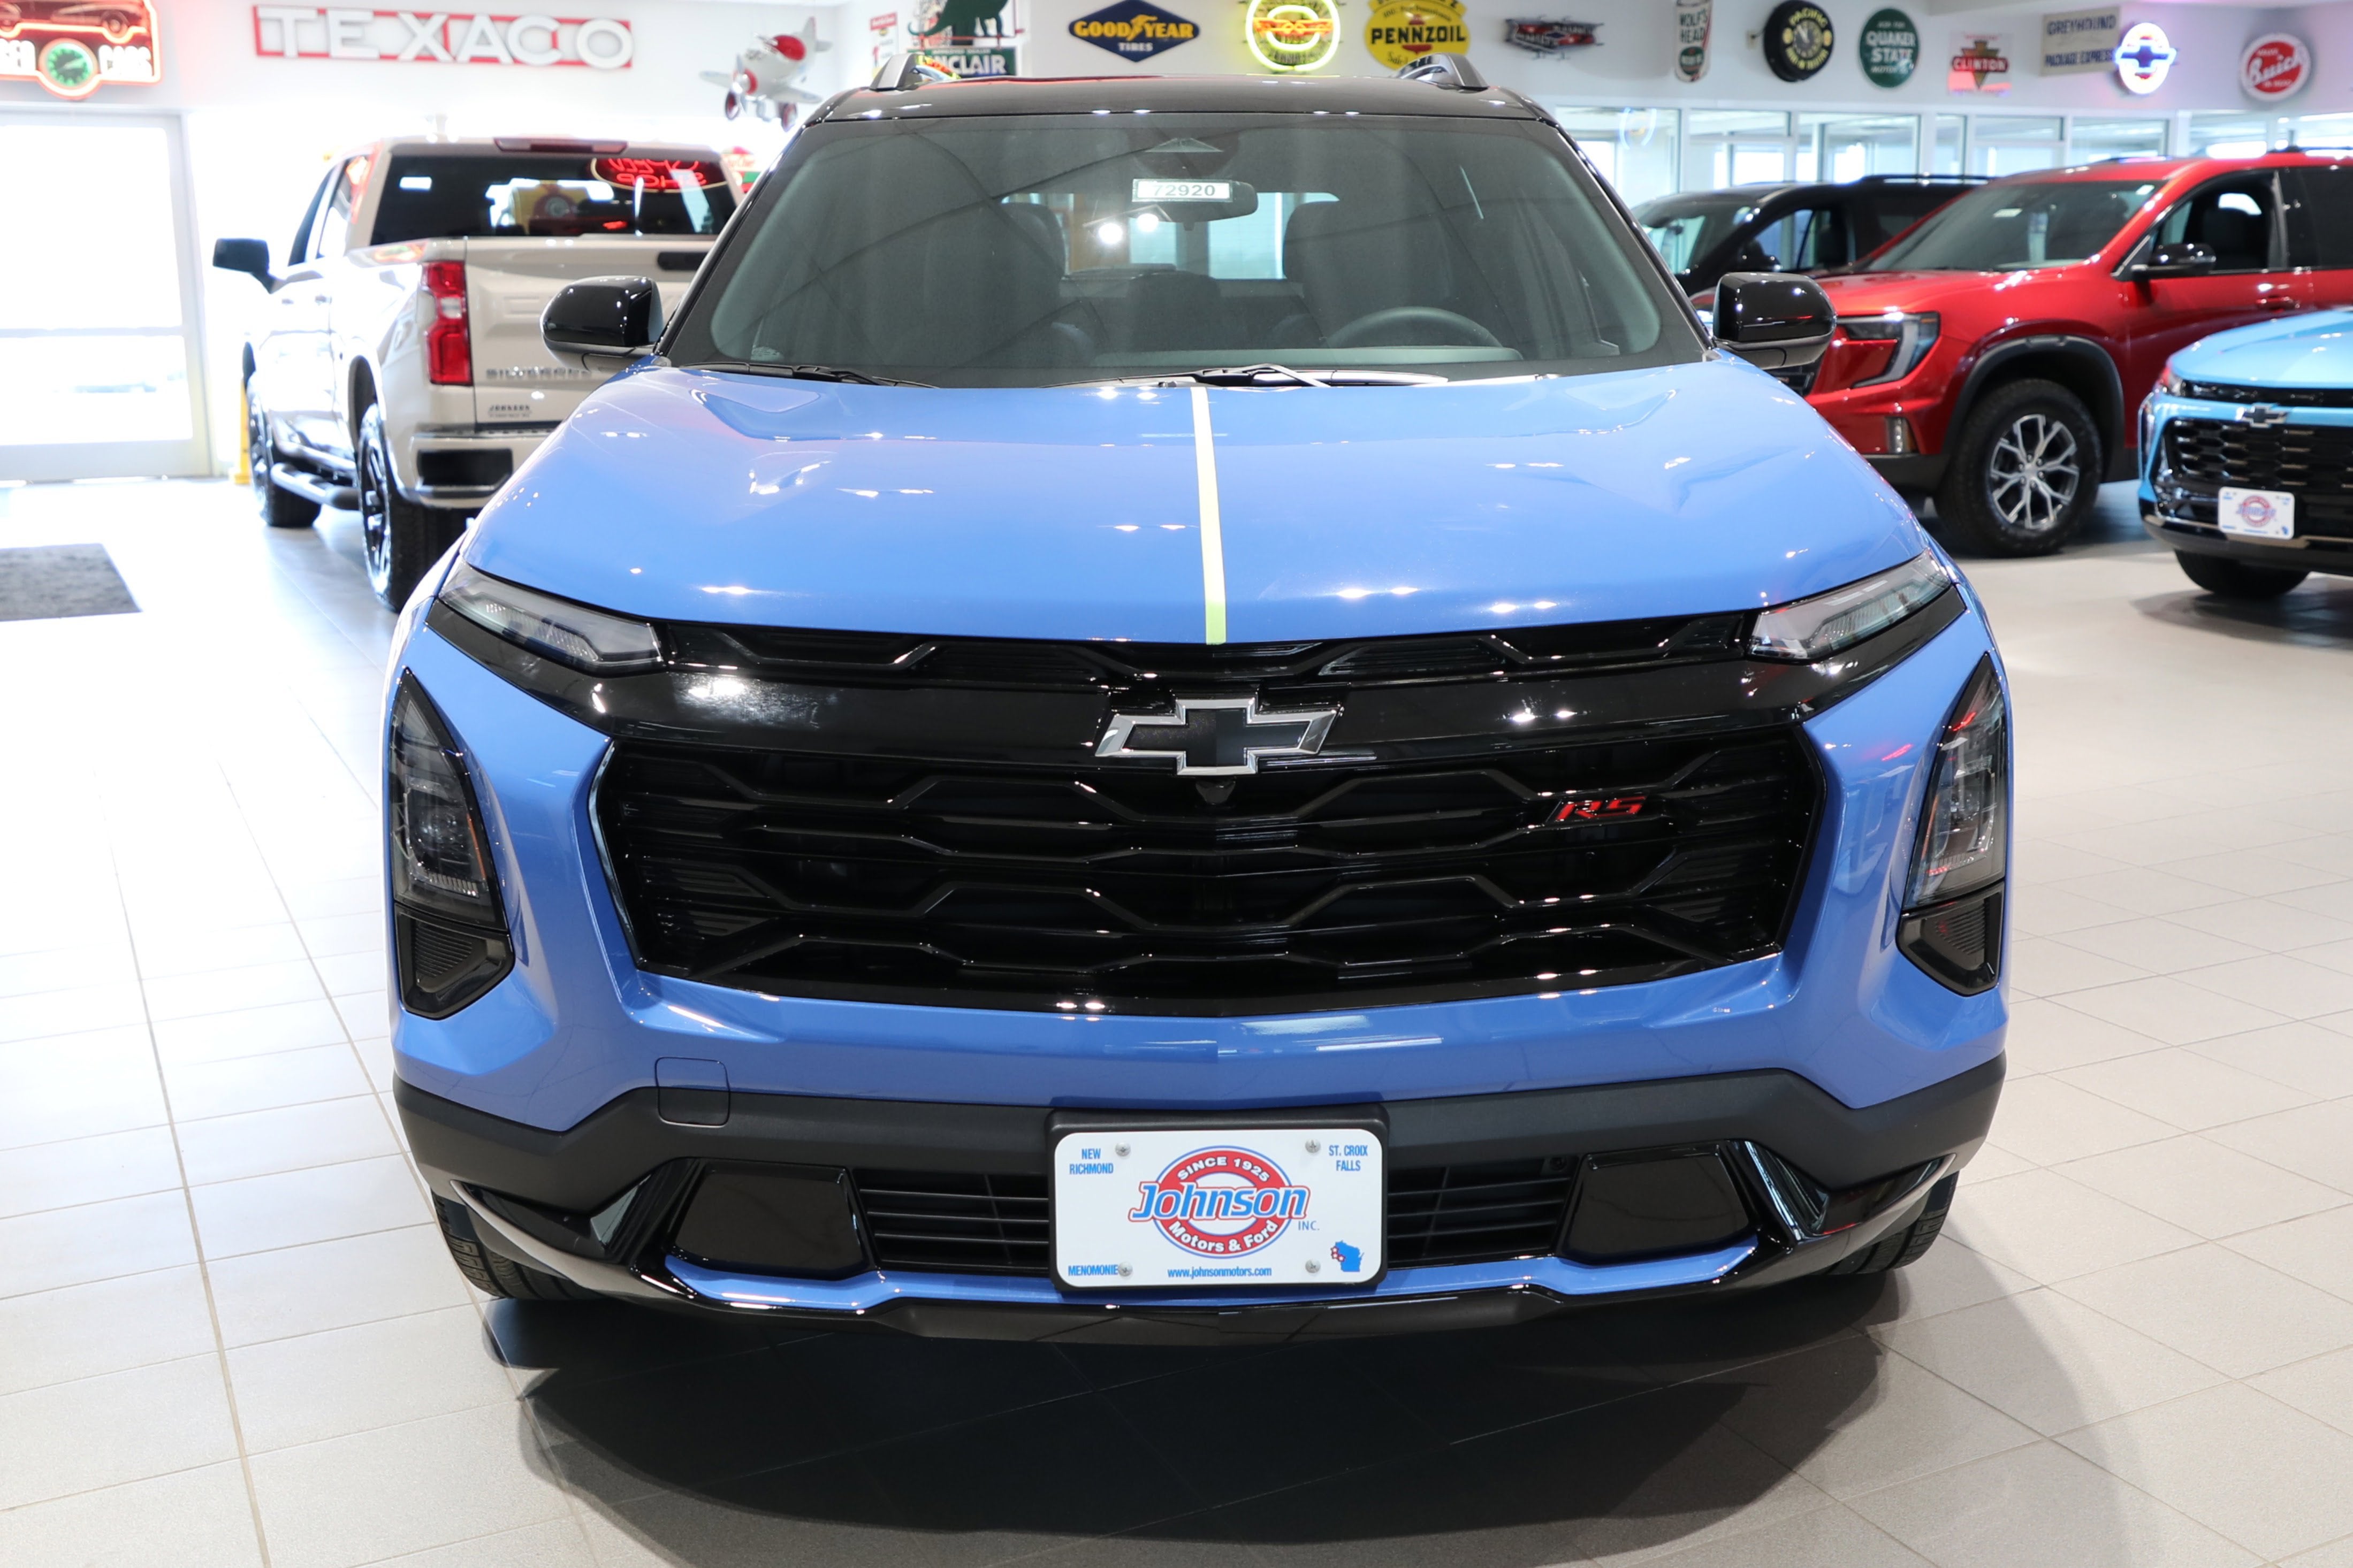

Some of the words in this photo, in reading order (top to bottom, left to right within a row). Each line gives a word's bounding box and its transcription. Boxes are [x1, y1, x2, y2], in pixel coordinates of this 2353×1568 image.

[2046, 14, 2117, 35] GREYHOUND
[257, 7, 634, 70] TEXACO
[1370, 25, 1467, 44] PENNZOIL
[1680, 27, 1705, 43] HEAD
[1865, 30, 1916, 47] QUAKER
[1118, 42, 1153, 51] TIRES
[1871, 48, 1914, 63] STATE
[1953, 57, 2006, 71] CLINTON
[2249, 45, 2303, 86] Buick
[1154, 185, 1216, 197] 72920
[1555, 795, 1647, 822] RS
[1081, 1149, 1101, 1159] NEW
[1328, 1145, 1343, 1157] ST.
[1344, 1145, 1368, 1157] CROIX
[1069, 1163, 1114, 1175] RICHMOND
[1177, 1157, 1228, 1181] SINCE
[1233, 1158, 1270, 1182] 1925
[1336, 1160, 1361, 1172] FALLS
[1130, 1181, 1310, 1221] Johnson
[1298, 1221, 1320, 1231] INC.
[1169, 1221, 1225, 1252] Motors
[1229, 1239, 1242, 1252] &
[1244, 1220, 1278, 1249] Ford
[1068, 1264, 1119, 1276] MENOMONIE
[1167, 1267, 1272, 1279] www.johnsonmotors.com
